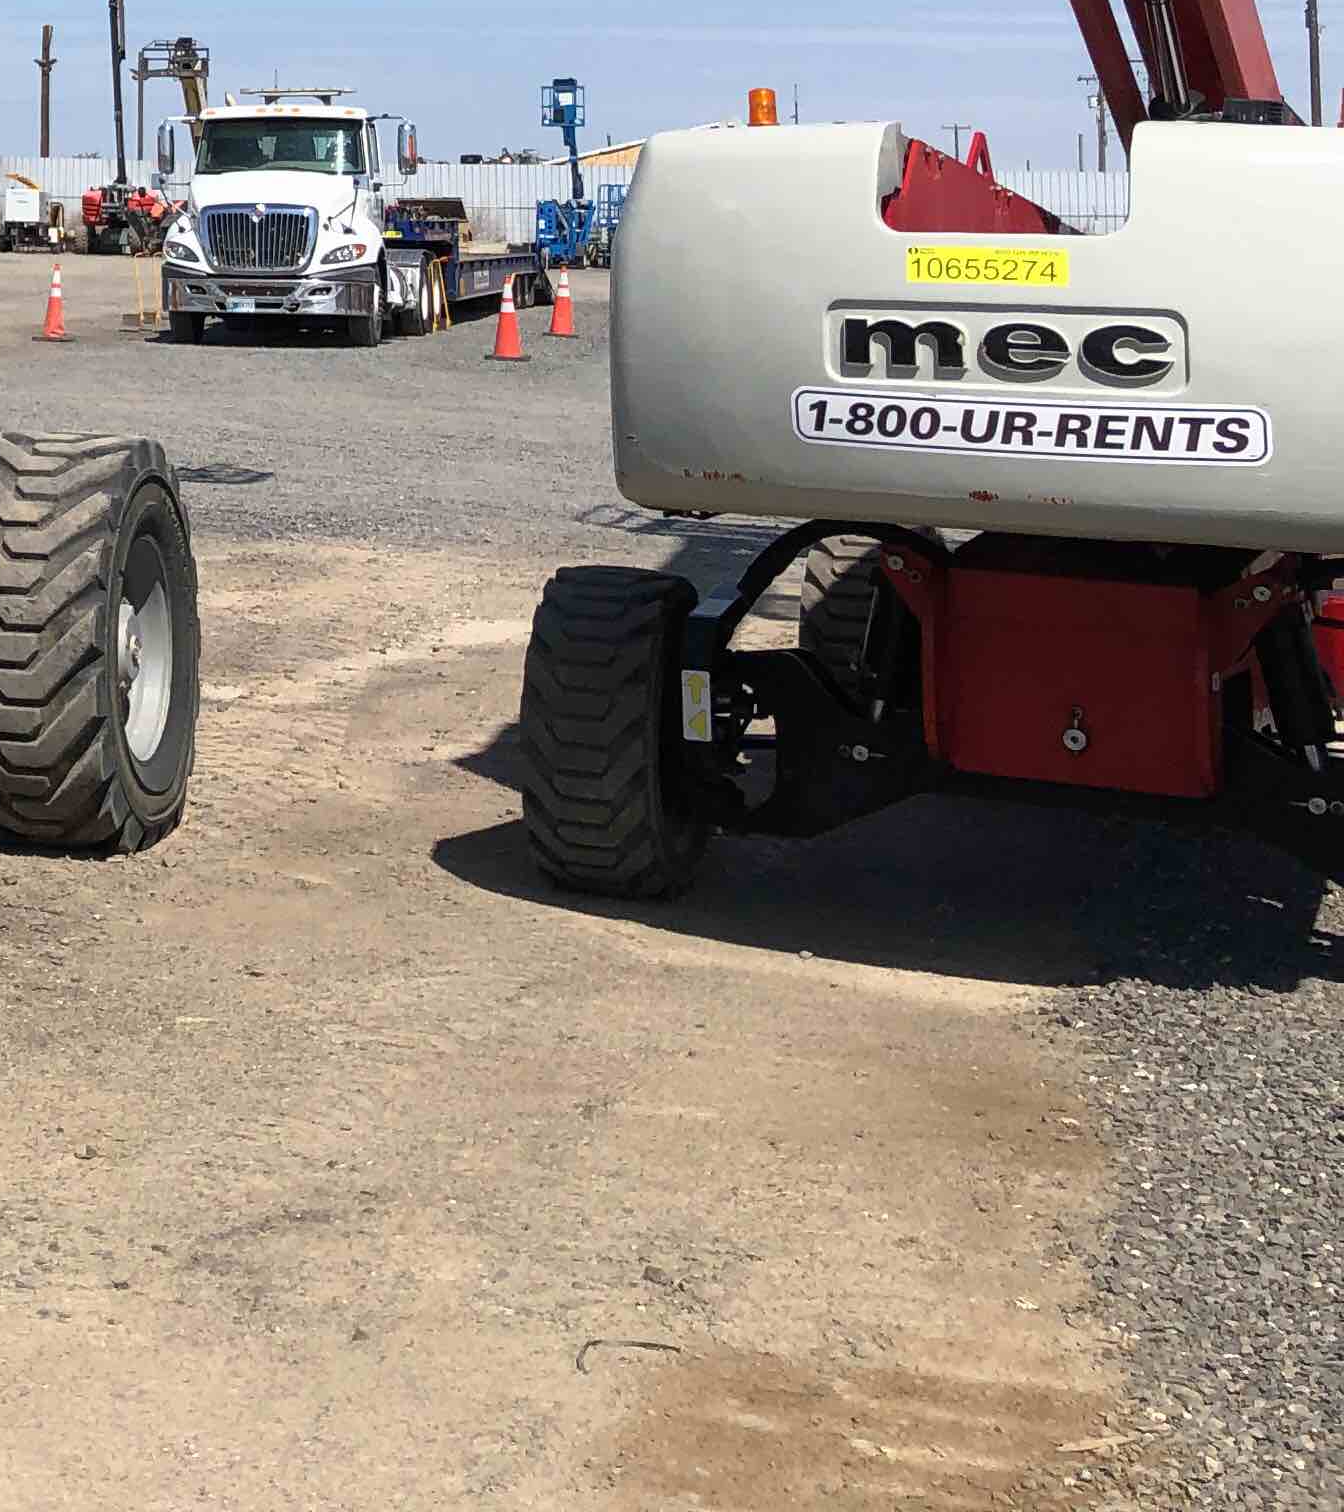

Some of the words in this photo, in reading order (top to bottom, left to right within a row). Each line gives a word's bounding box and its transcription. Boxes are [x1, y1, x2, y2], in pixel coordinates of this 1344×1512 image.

[911, 256, 1058, 283] 10655274
[839, 317, 1177, 389] mec
[807, 399, 1252, 455] 1-800-UR-RENTS
